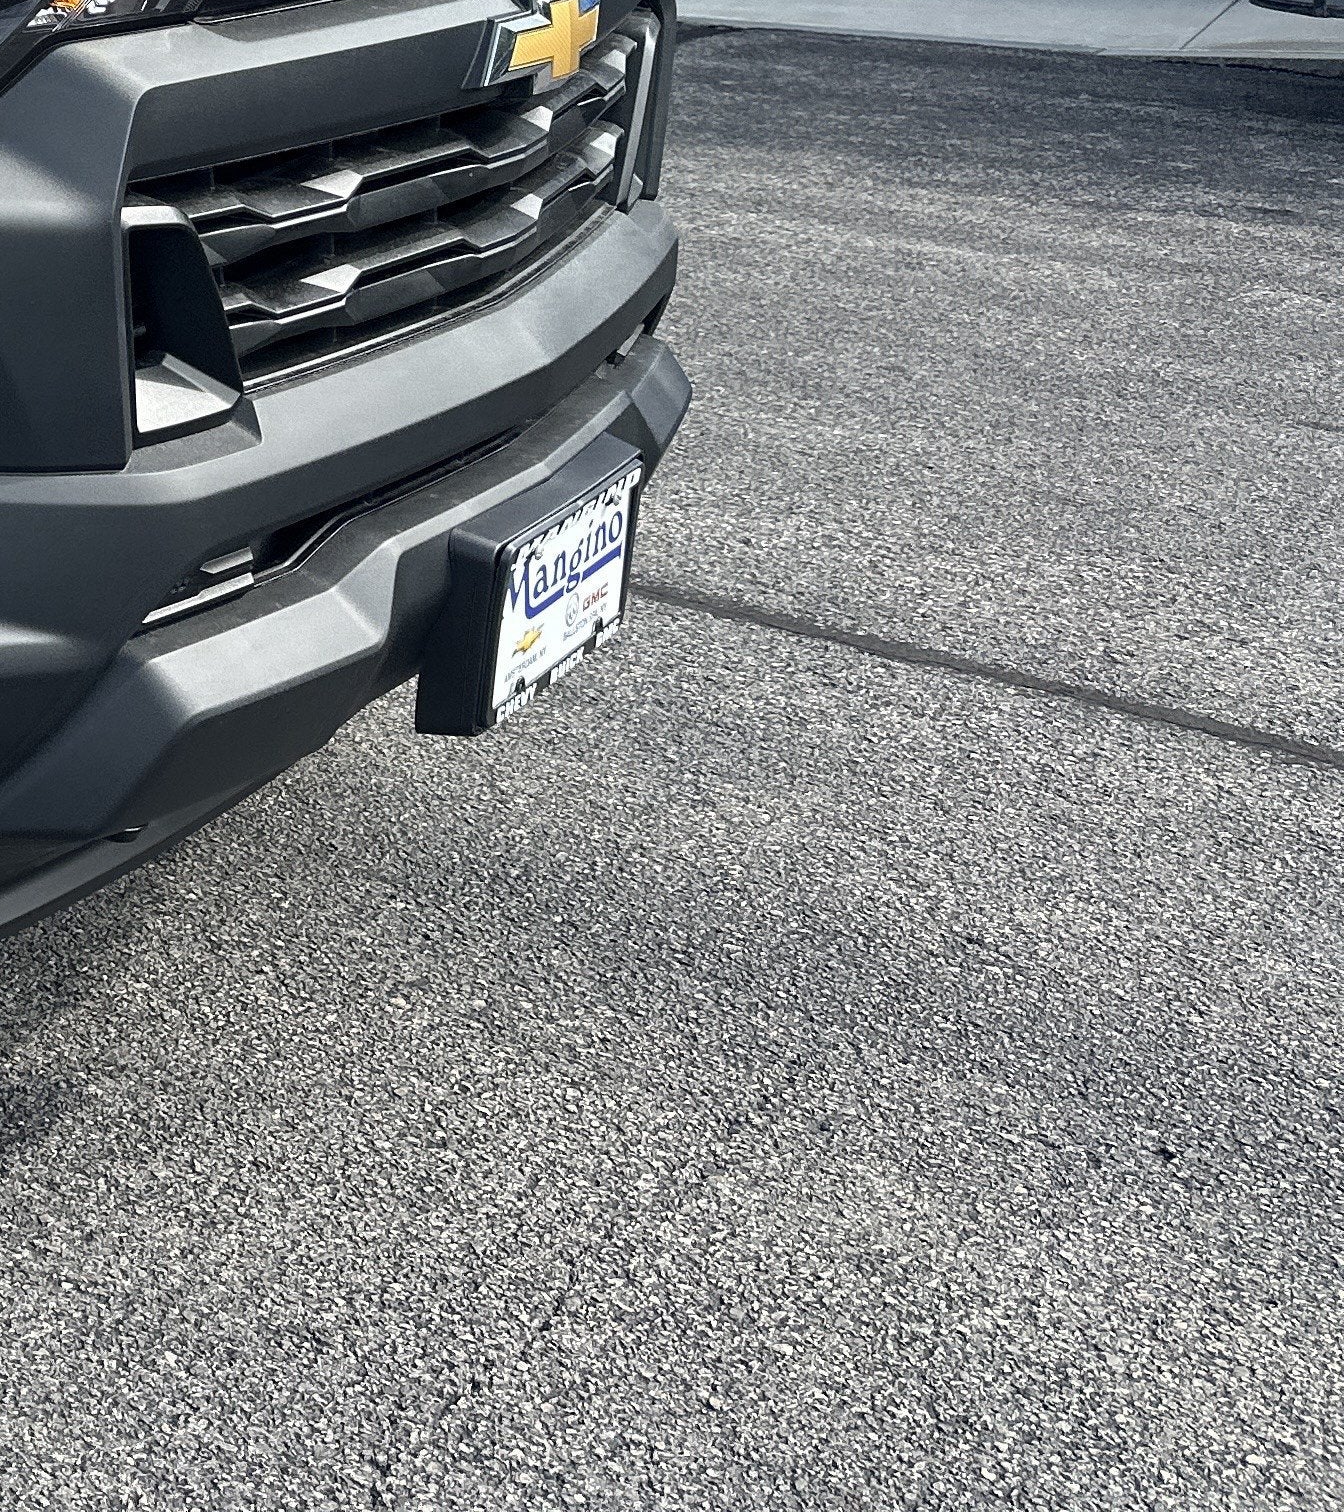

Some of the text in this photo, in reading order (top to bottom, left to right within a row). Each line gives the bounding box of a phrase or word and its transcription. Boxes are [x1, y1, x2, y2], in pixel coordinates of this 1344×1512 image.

[508, 510, 624, 619] Mangino
[583, 582, 609, 612] GMC
[496, 682, 537, 723] CHEVY
[550, 646, 585, 685] BUICK
